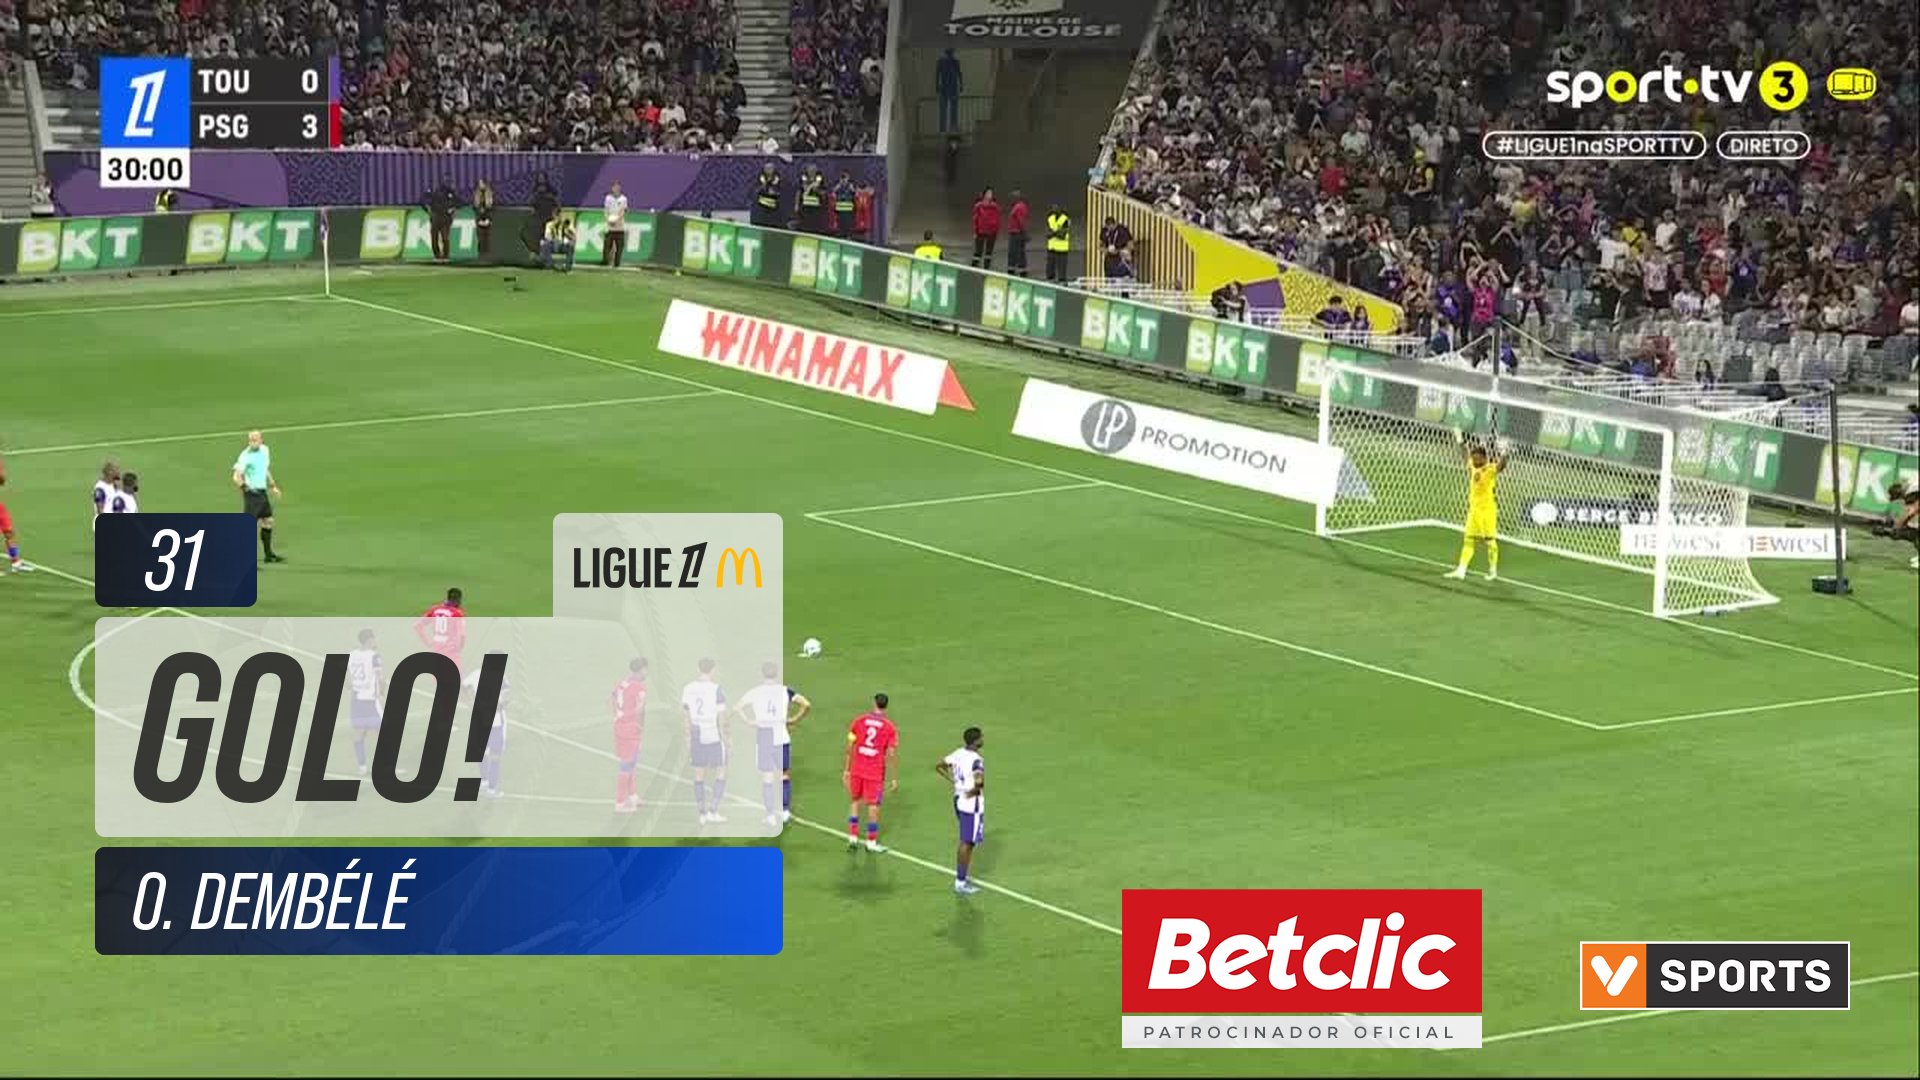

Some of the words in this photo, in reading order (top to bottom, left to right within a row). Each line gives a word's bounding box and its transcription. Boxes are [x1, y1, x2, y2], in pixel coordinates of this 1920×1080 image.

[944, 23, 1122, 37] TOULOUSE
[1057, 16, 1081, 25] DE
[22, 226, 139, 263] BKT
[190, 220, 311, 258] BKT
[684, 230, 760, 268] BKT
[793, 248, 862, 289] BKT
[888, 264, 956, 307] BKT
[983, 286, 1054, 332] BKT
[1083, 308, 1157, 353] BKT
[701, 311, 905, 402] WINAMAX
[1190, 333, 1266, 373] BKT
[1140, 425, 1287, 474] PROMOTION
[1639, 509, 1724, 525] BNCO
[865, 727, 877, 747] 2
